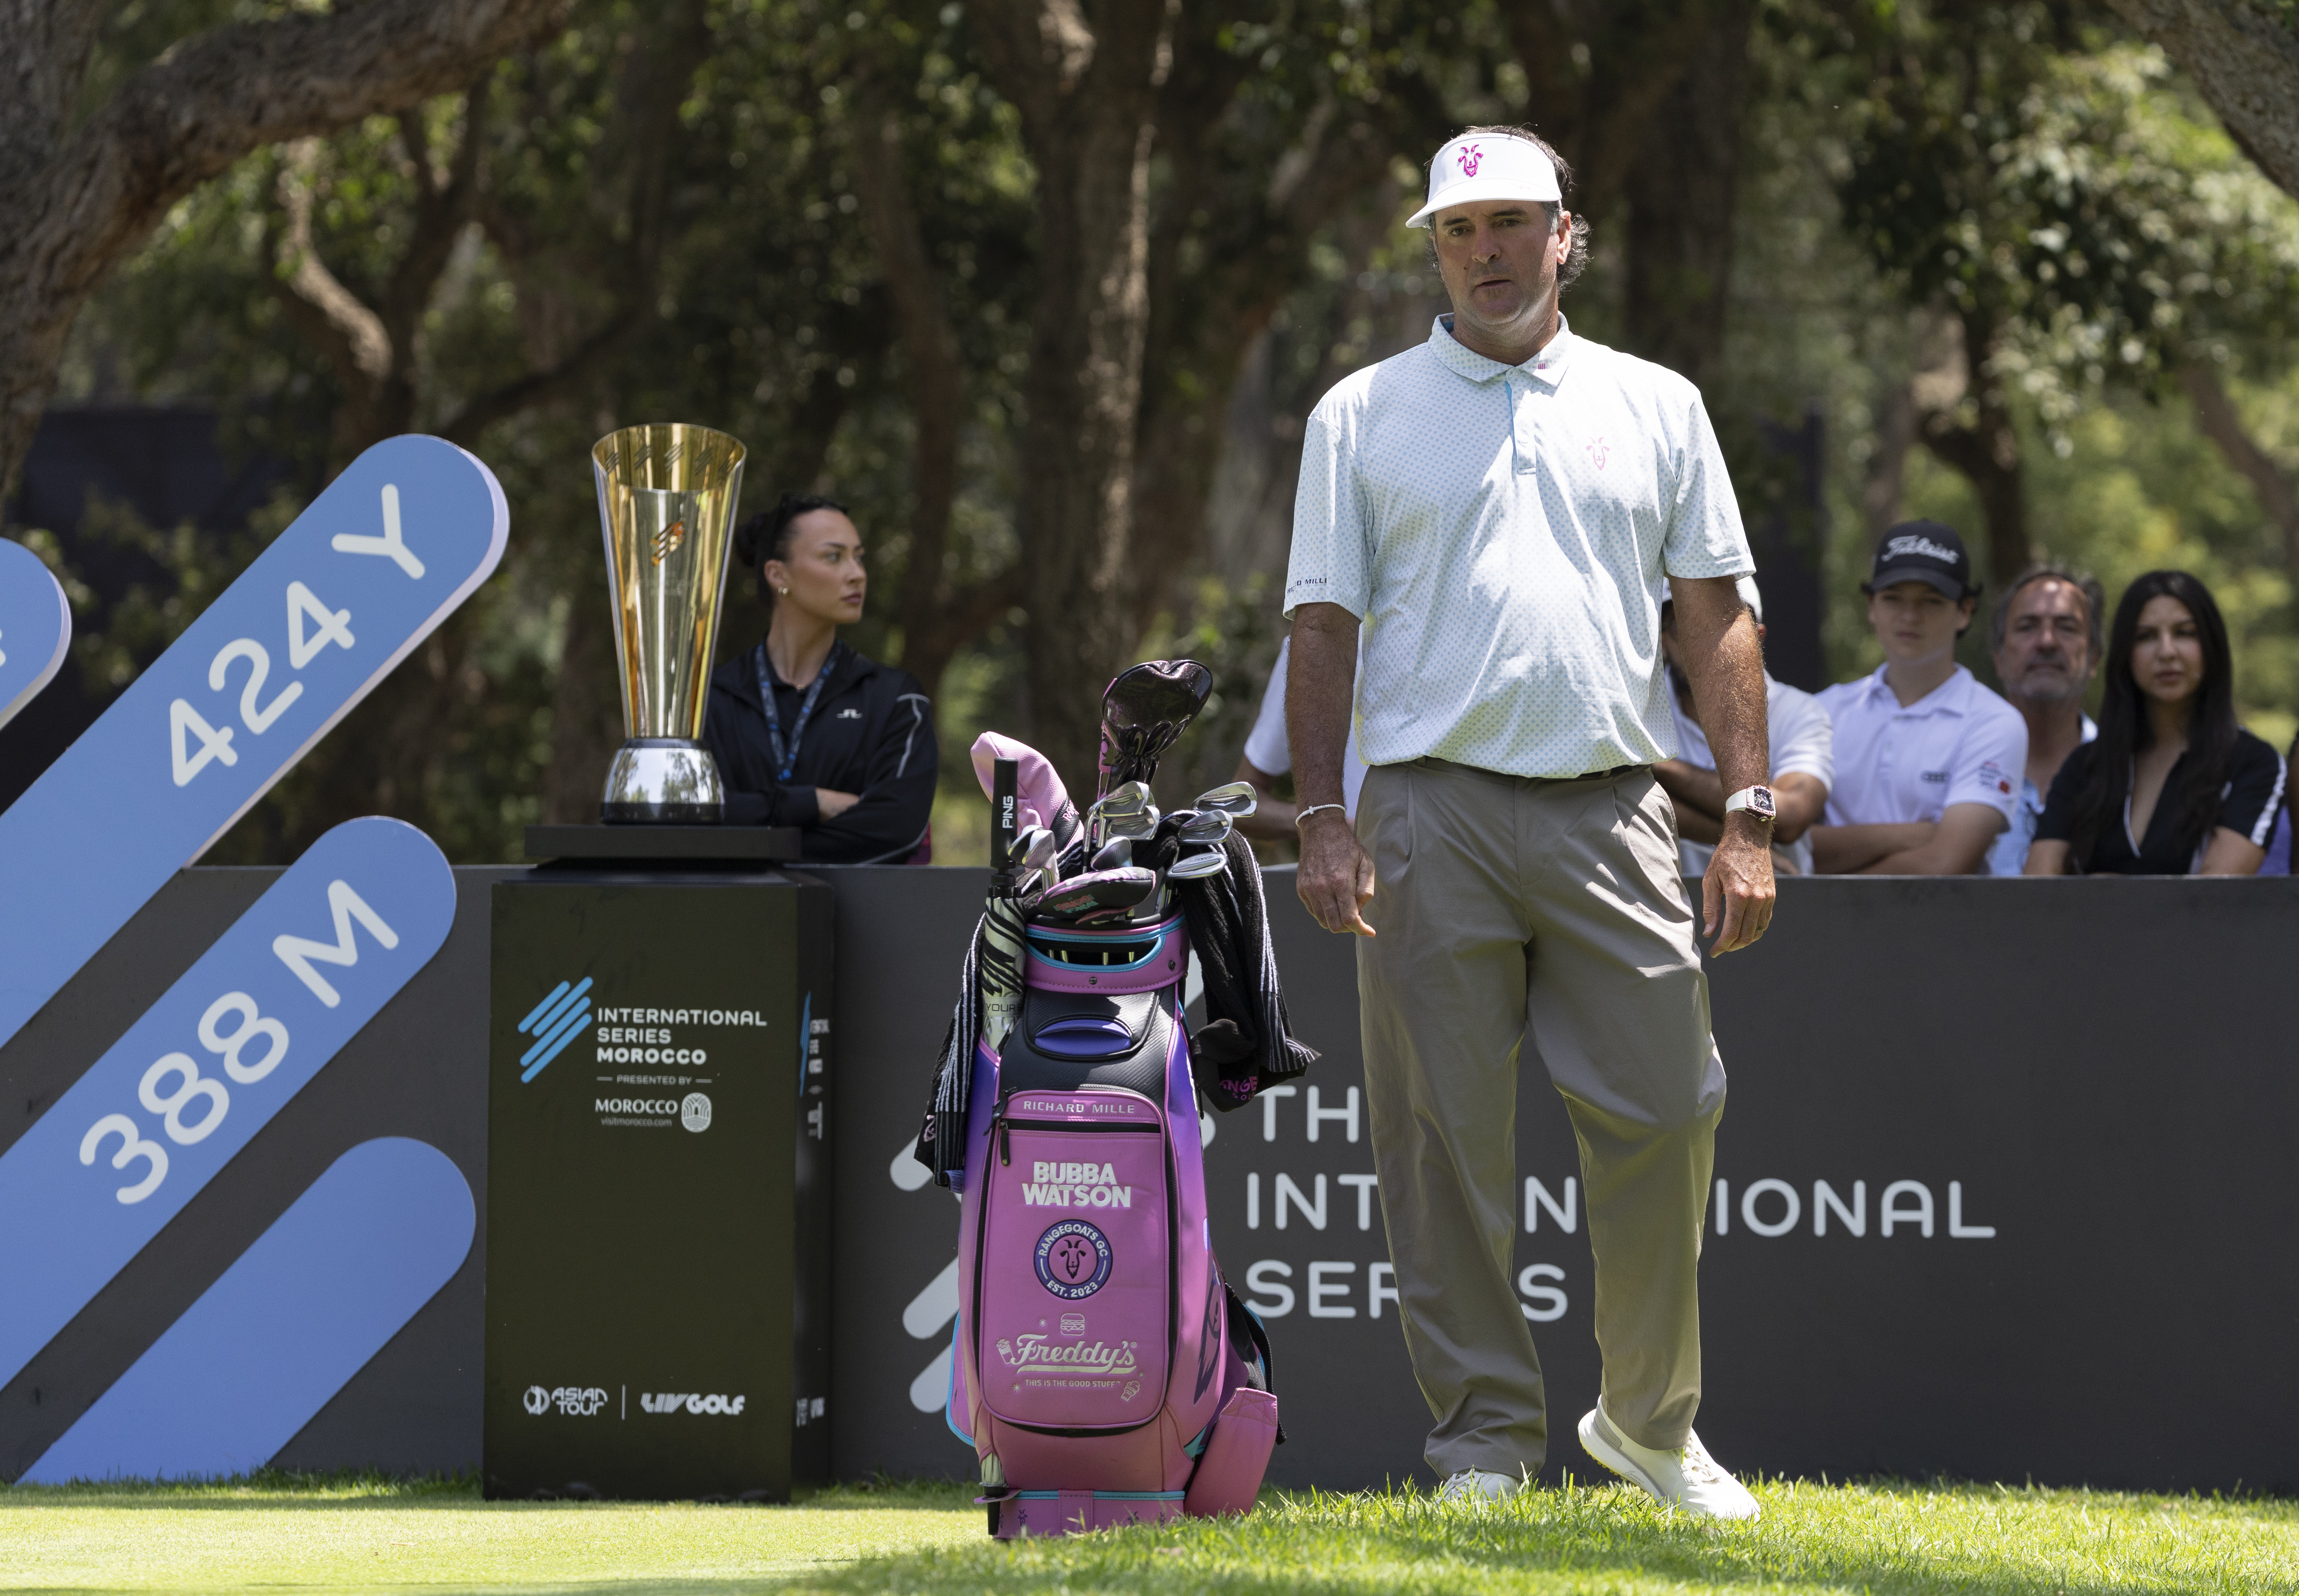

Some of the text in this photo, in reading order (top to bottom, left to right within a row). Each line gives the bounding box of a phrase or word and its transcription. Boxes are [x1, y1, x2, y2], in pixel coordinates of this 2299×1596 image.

[169, 483, 425, 787] 424 Y
[1002, 796, 1013, 828] PING
[598, 1007, 767, 1026] INTERNATIONAL
[986, 1003, 1015, 1012] YOUR
[79, 879, 399, 1205] 388 M
[597, 1027, 671, 1044] SERIES
[597, 1047, 706, 1065] MOROCCO
[617, 1075, 692, 1085] PRESENTED BY
[595, 1099, 678, 1114] MOROCCO
[1023, 1100, 1135, 1113] RICHARD MILLE
[1254, 1086, 1359, 1143] TH
[601, 1116, 672, 1127] visitmorocco.com
[1033, 1162, 1116, 1185] BUBBA
[1022, 1183, 1131, 1208] WATSON
[1247, 1172, 1996, 1238] INTNIONAL
[1038, 1224, 1108, 1257] RANGEGOATS GC
[1047, 1280, 1098, 1297] EST. 2023
[551, 1387, 608, 1402] ASIAN
[556, 1401, 604, 1415] TOUR
